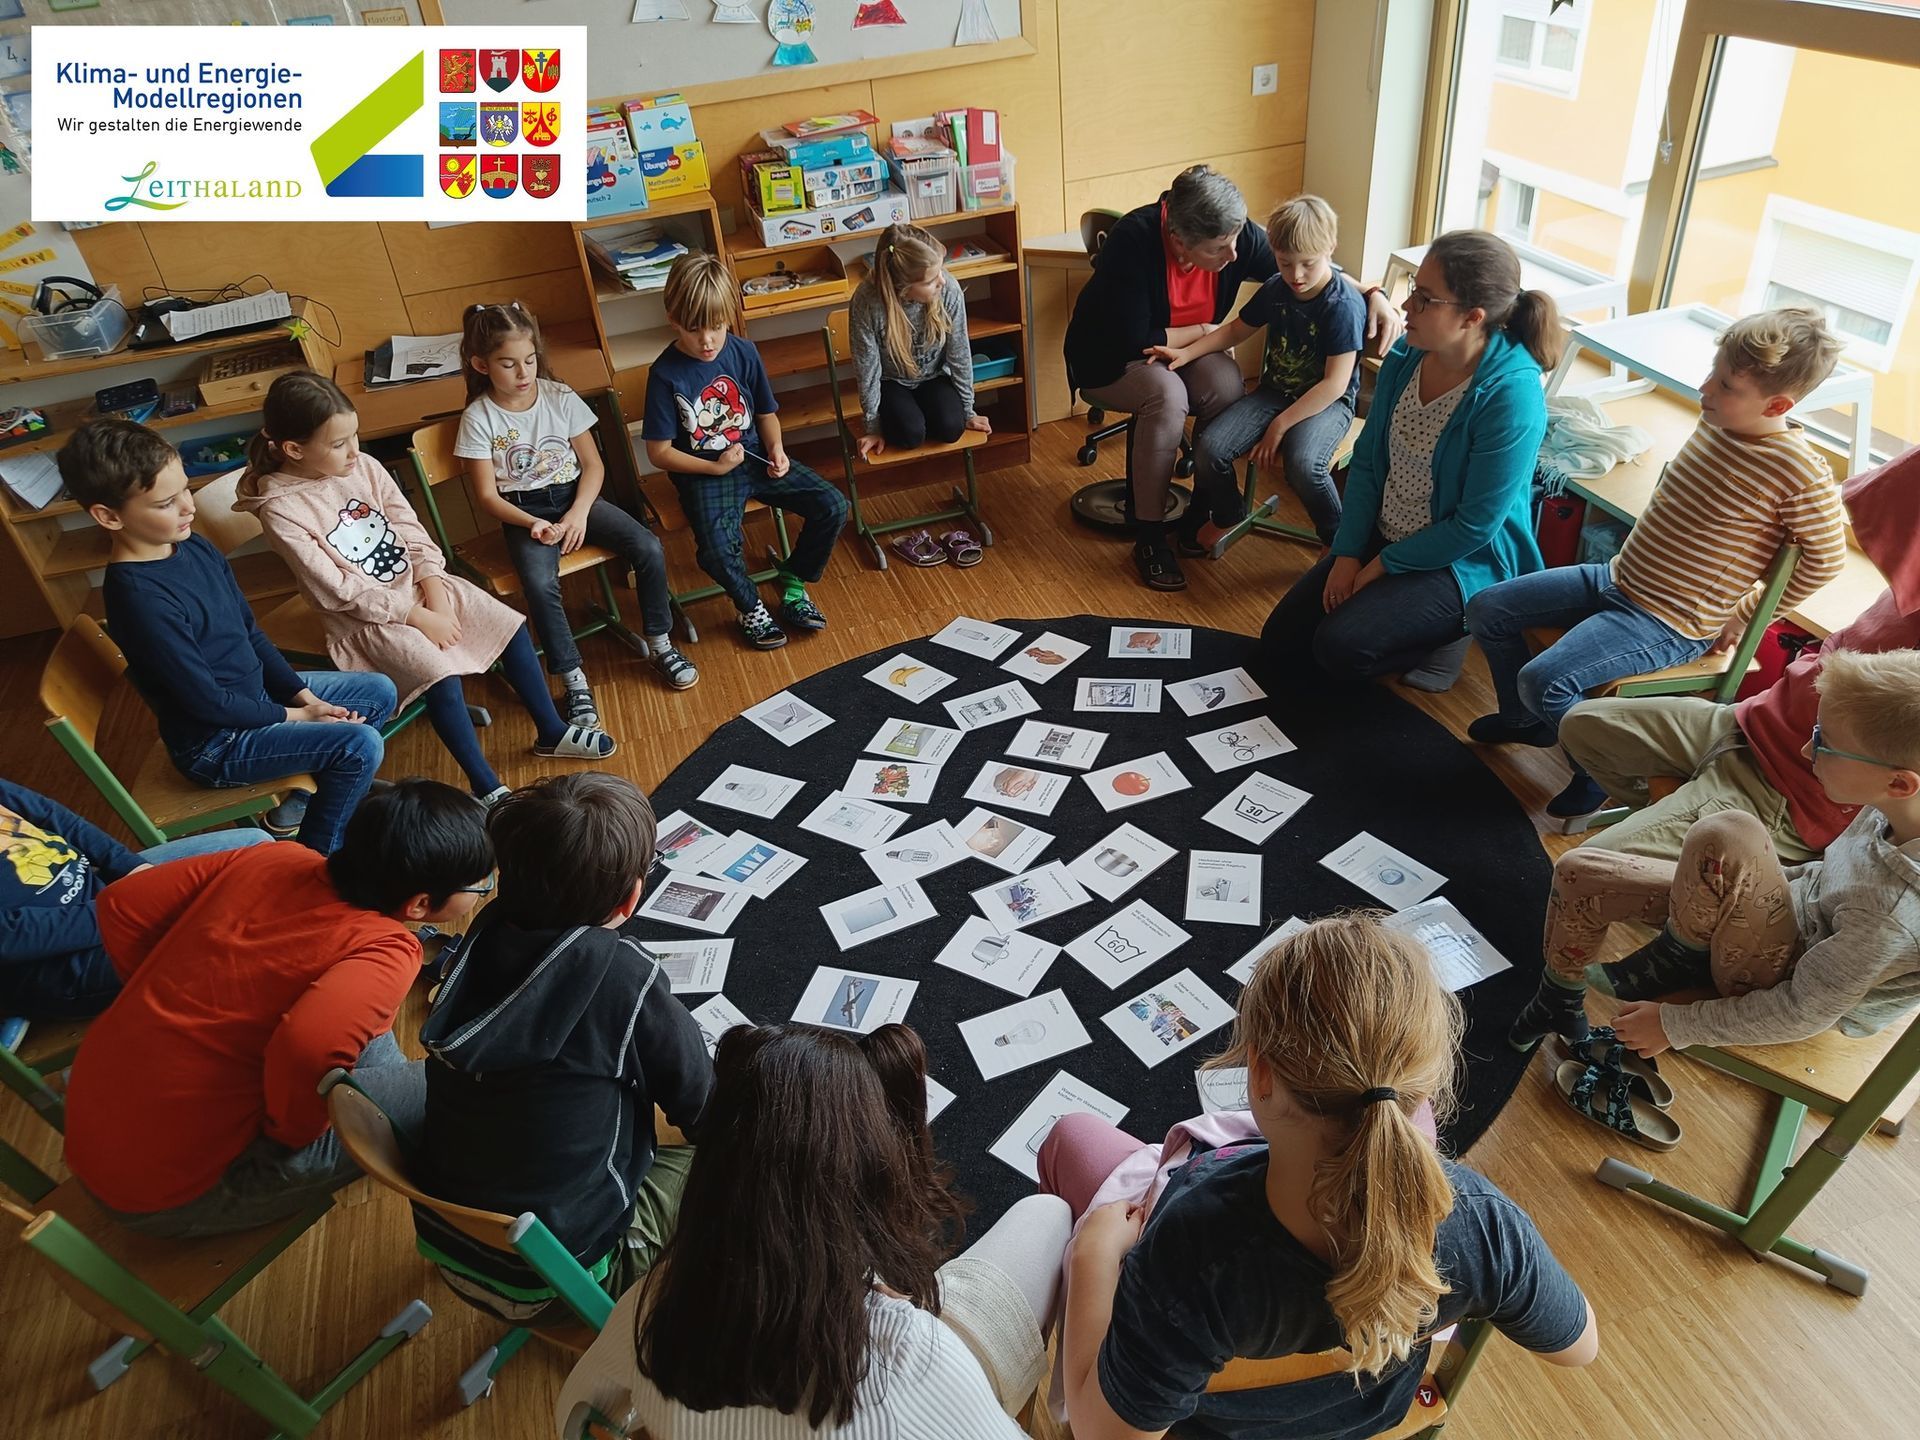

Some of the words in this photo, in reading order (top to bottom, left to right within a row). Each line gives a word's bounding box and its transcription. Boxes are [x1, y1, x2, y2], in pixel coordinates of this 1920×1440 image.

[1246, 806, 1263, 816] 30
[60, 874, 85, 904] GOOD
[1107, 940, 1126, 953] 60
[420, 1389, 431, 1404] 4
